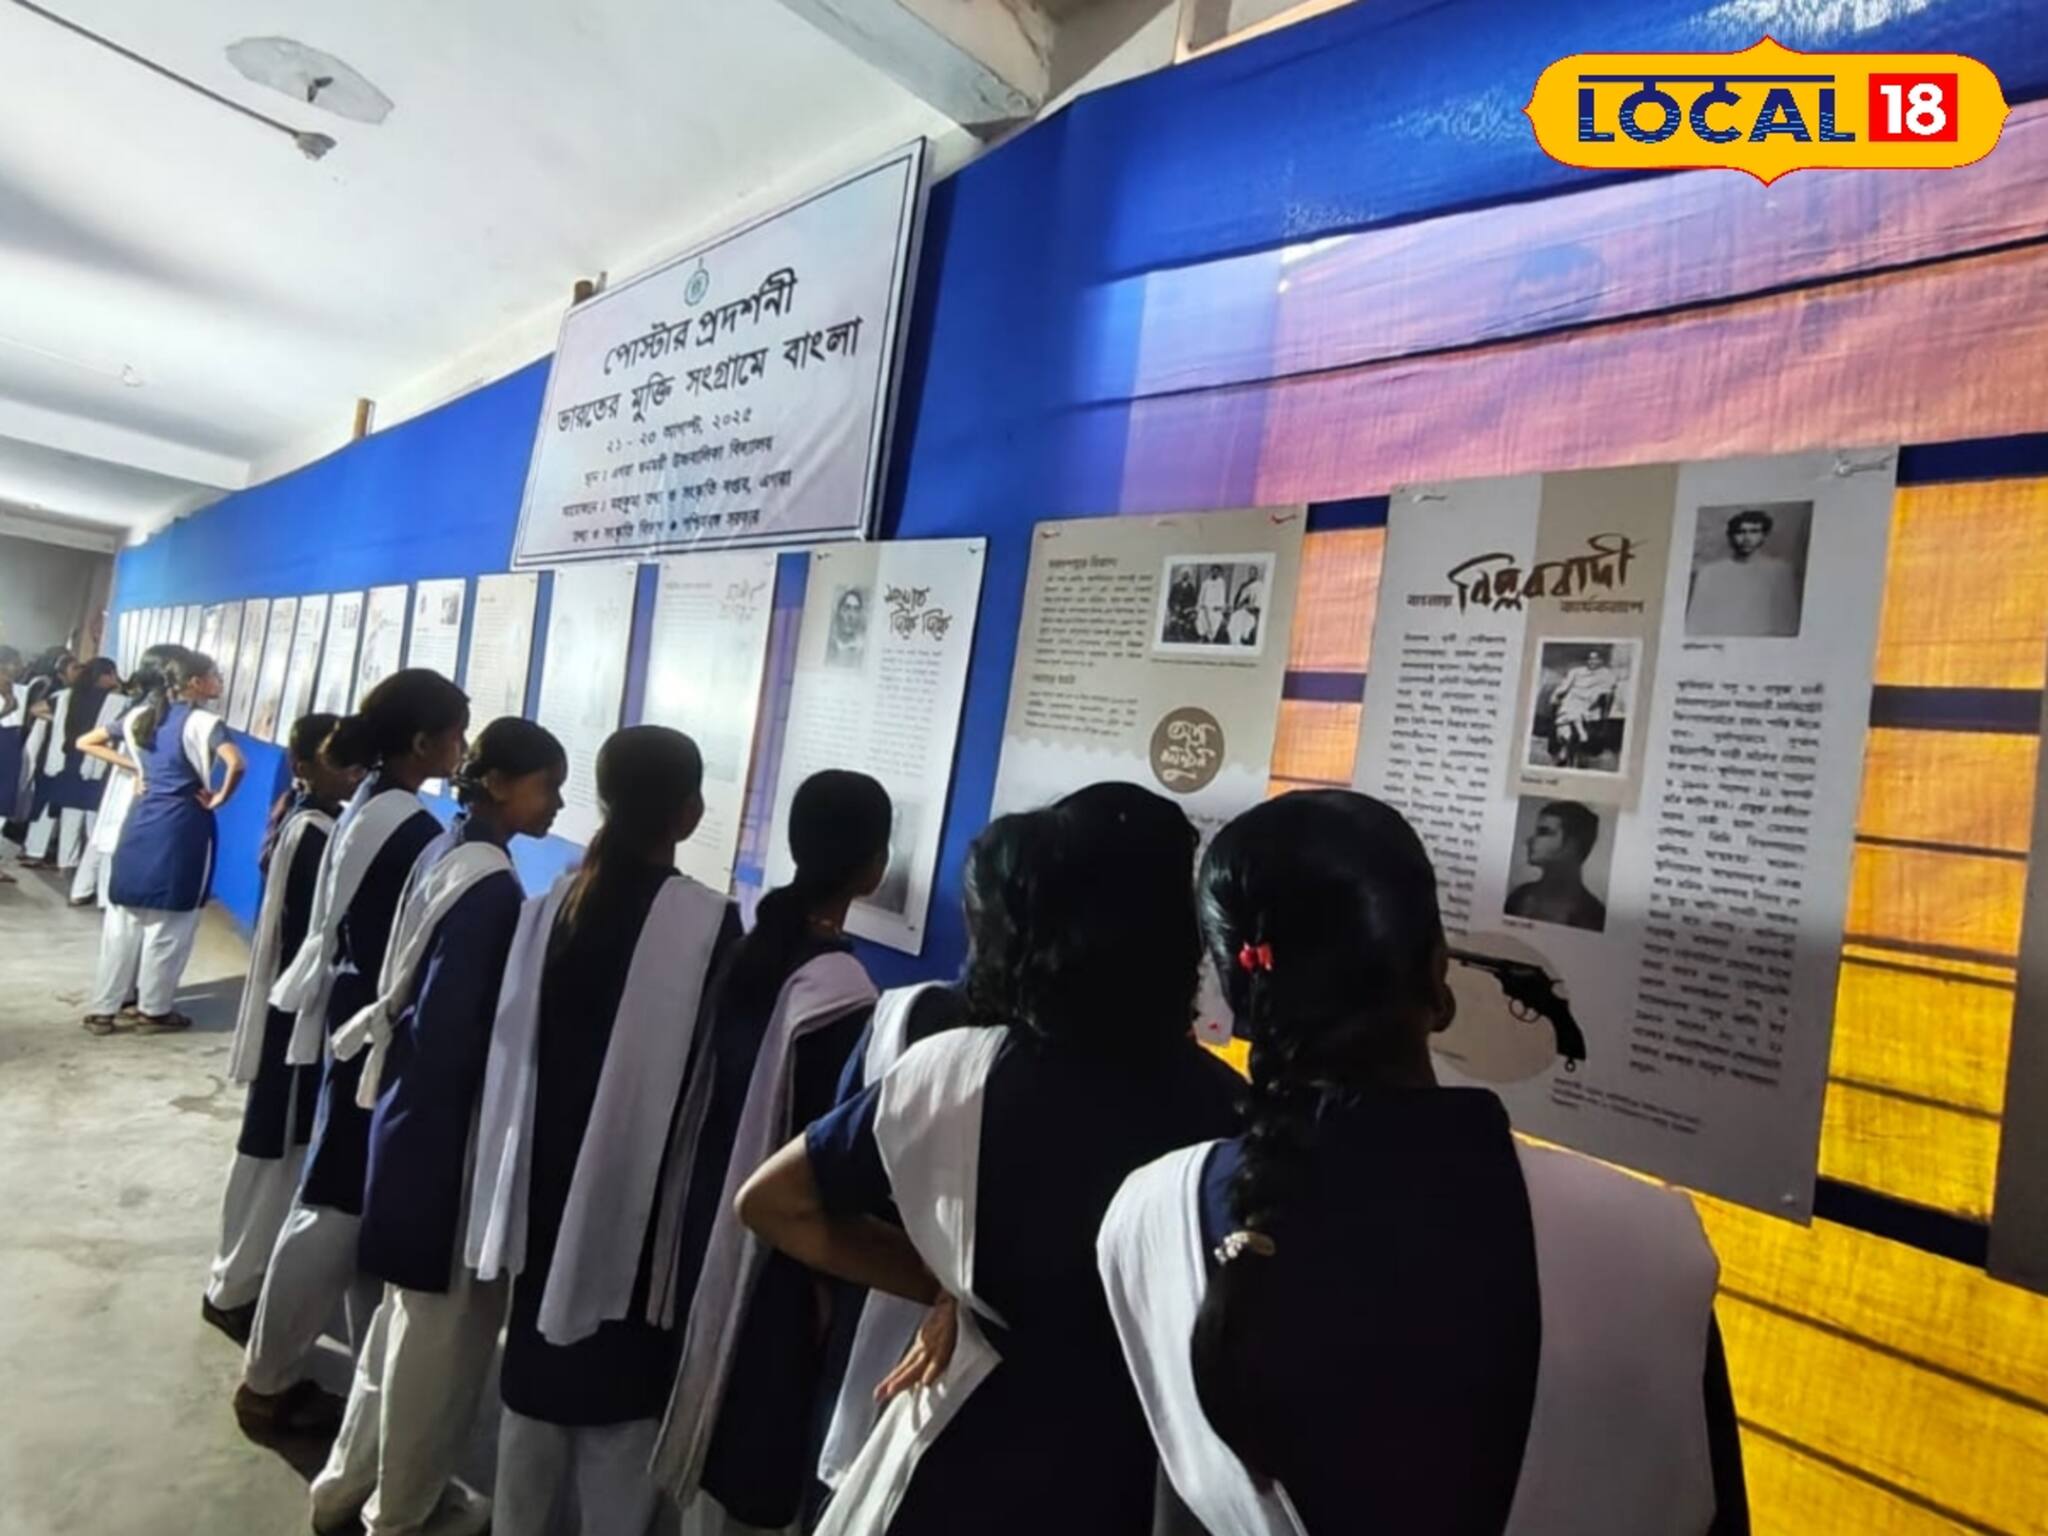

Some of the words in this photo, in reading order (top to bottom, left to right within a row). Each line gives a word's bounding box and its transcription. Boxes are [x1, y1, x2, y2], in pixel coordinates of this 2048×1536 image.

[558, 394, 622, 432] ভারতের
[631, 372, 676, 423] মুক্তি
[686, 346, 769, 401] সংগ্রামে
[783, 316, 863, 371] বাংলা
[603, 316, 690, 376] পোস্টার
[697, 267, 798, 347] প্রদর্শনী
